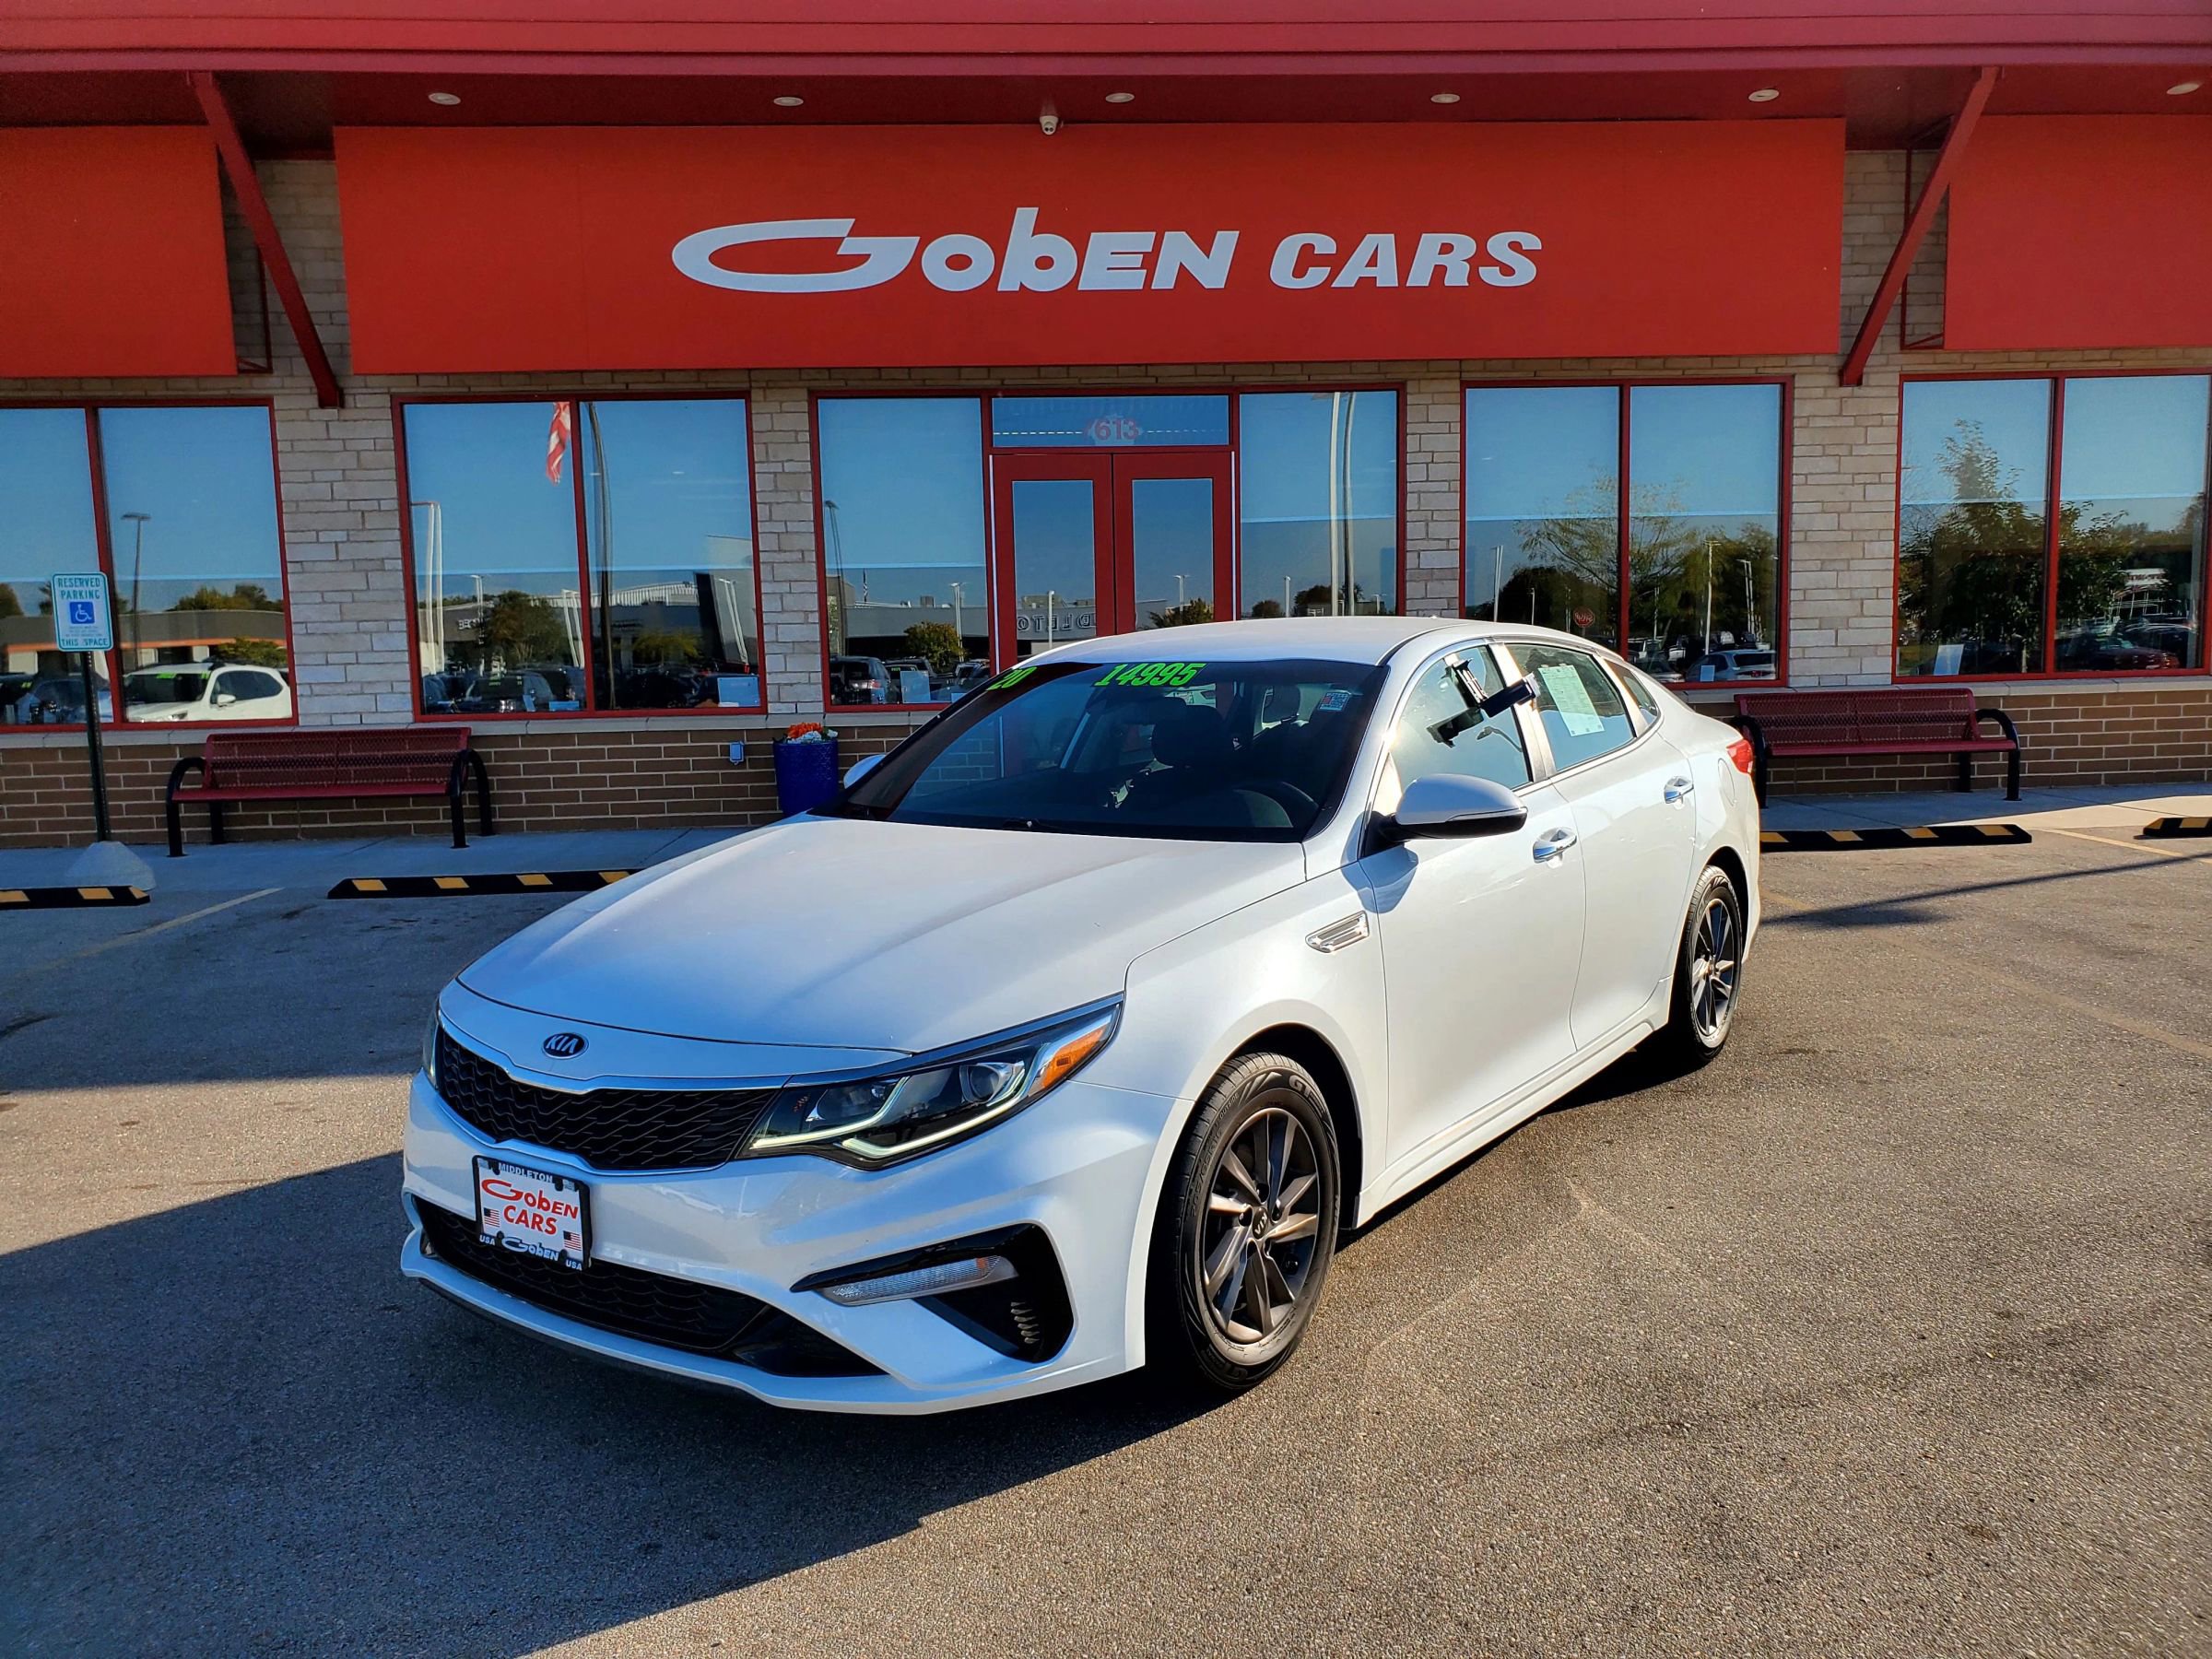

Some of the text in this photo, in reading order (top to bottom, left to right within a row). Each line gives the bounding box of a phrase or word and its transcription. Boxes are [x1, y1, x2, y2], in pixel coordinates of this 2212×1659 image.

[1269, 230, 1543, 289] CARS
[57, 577, 100, 588] RESERVED
[60, 589, 100, 600] PARKING
[61, 637, 109, 646] THIS SPACE
[987, 666, 1038, 691] 20
[1093, 663, 1207, 687] 14995
[545, 1034, 579, 1054] KIA
[1219, 1092, 1240, 1119] OUTSIDE
[499, 1161, 553, 1183] MIDDLETON
[503, 1206, 558, 1235] CARS
[1254, 1212, 1268, 1235] KIA
[479, 1234, 496, 1246] USA
[566, 1258, 582, 1271] USA
